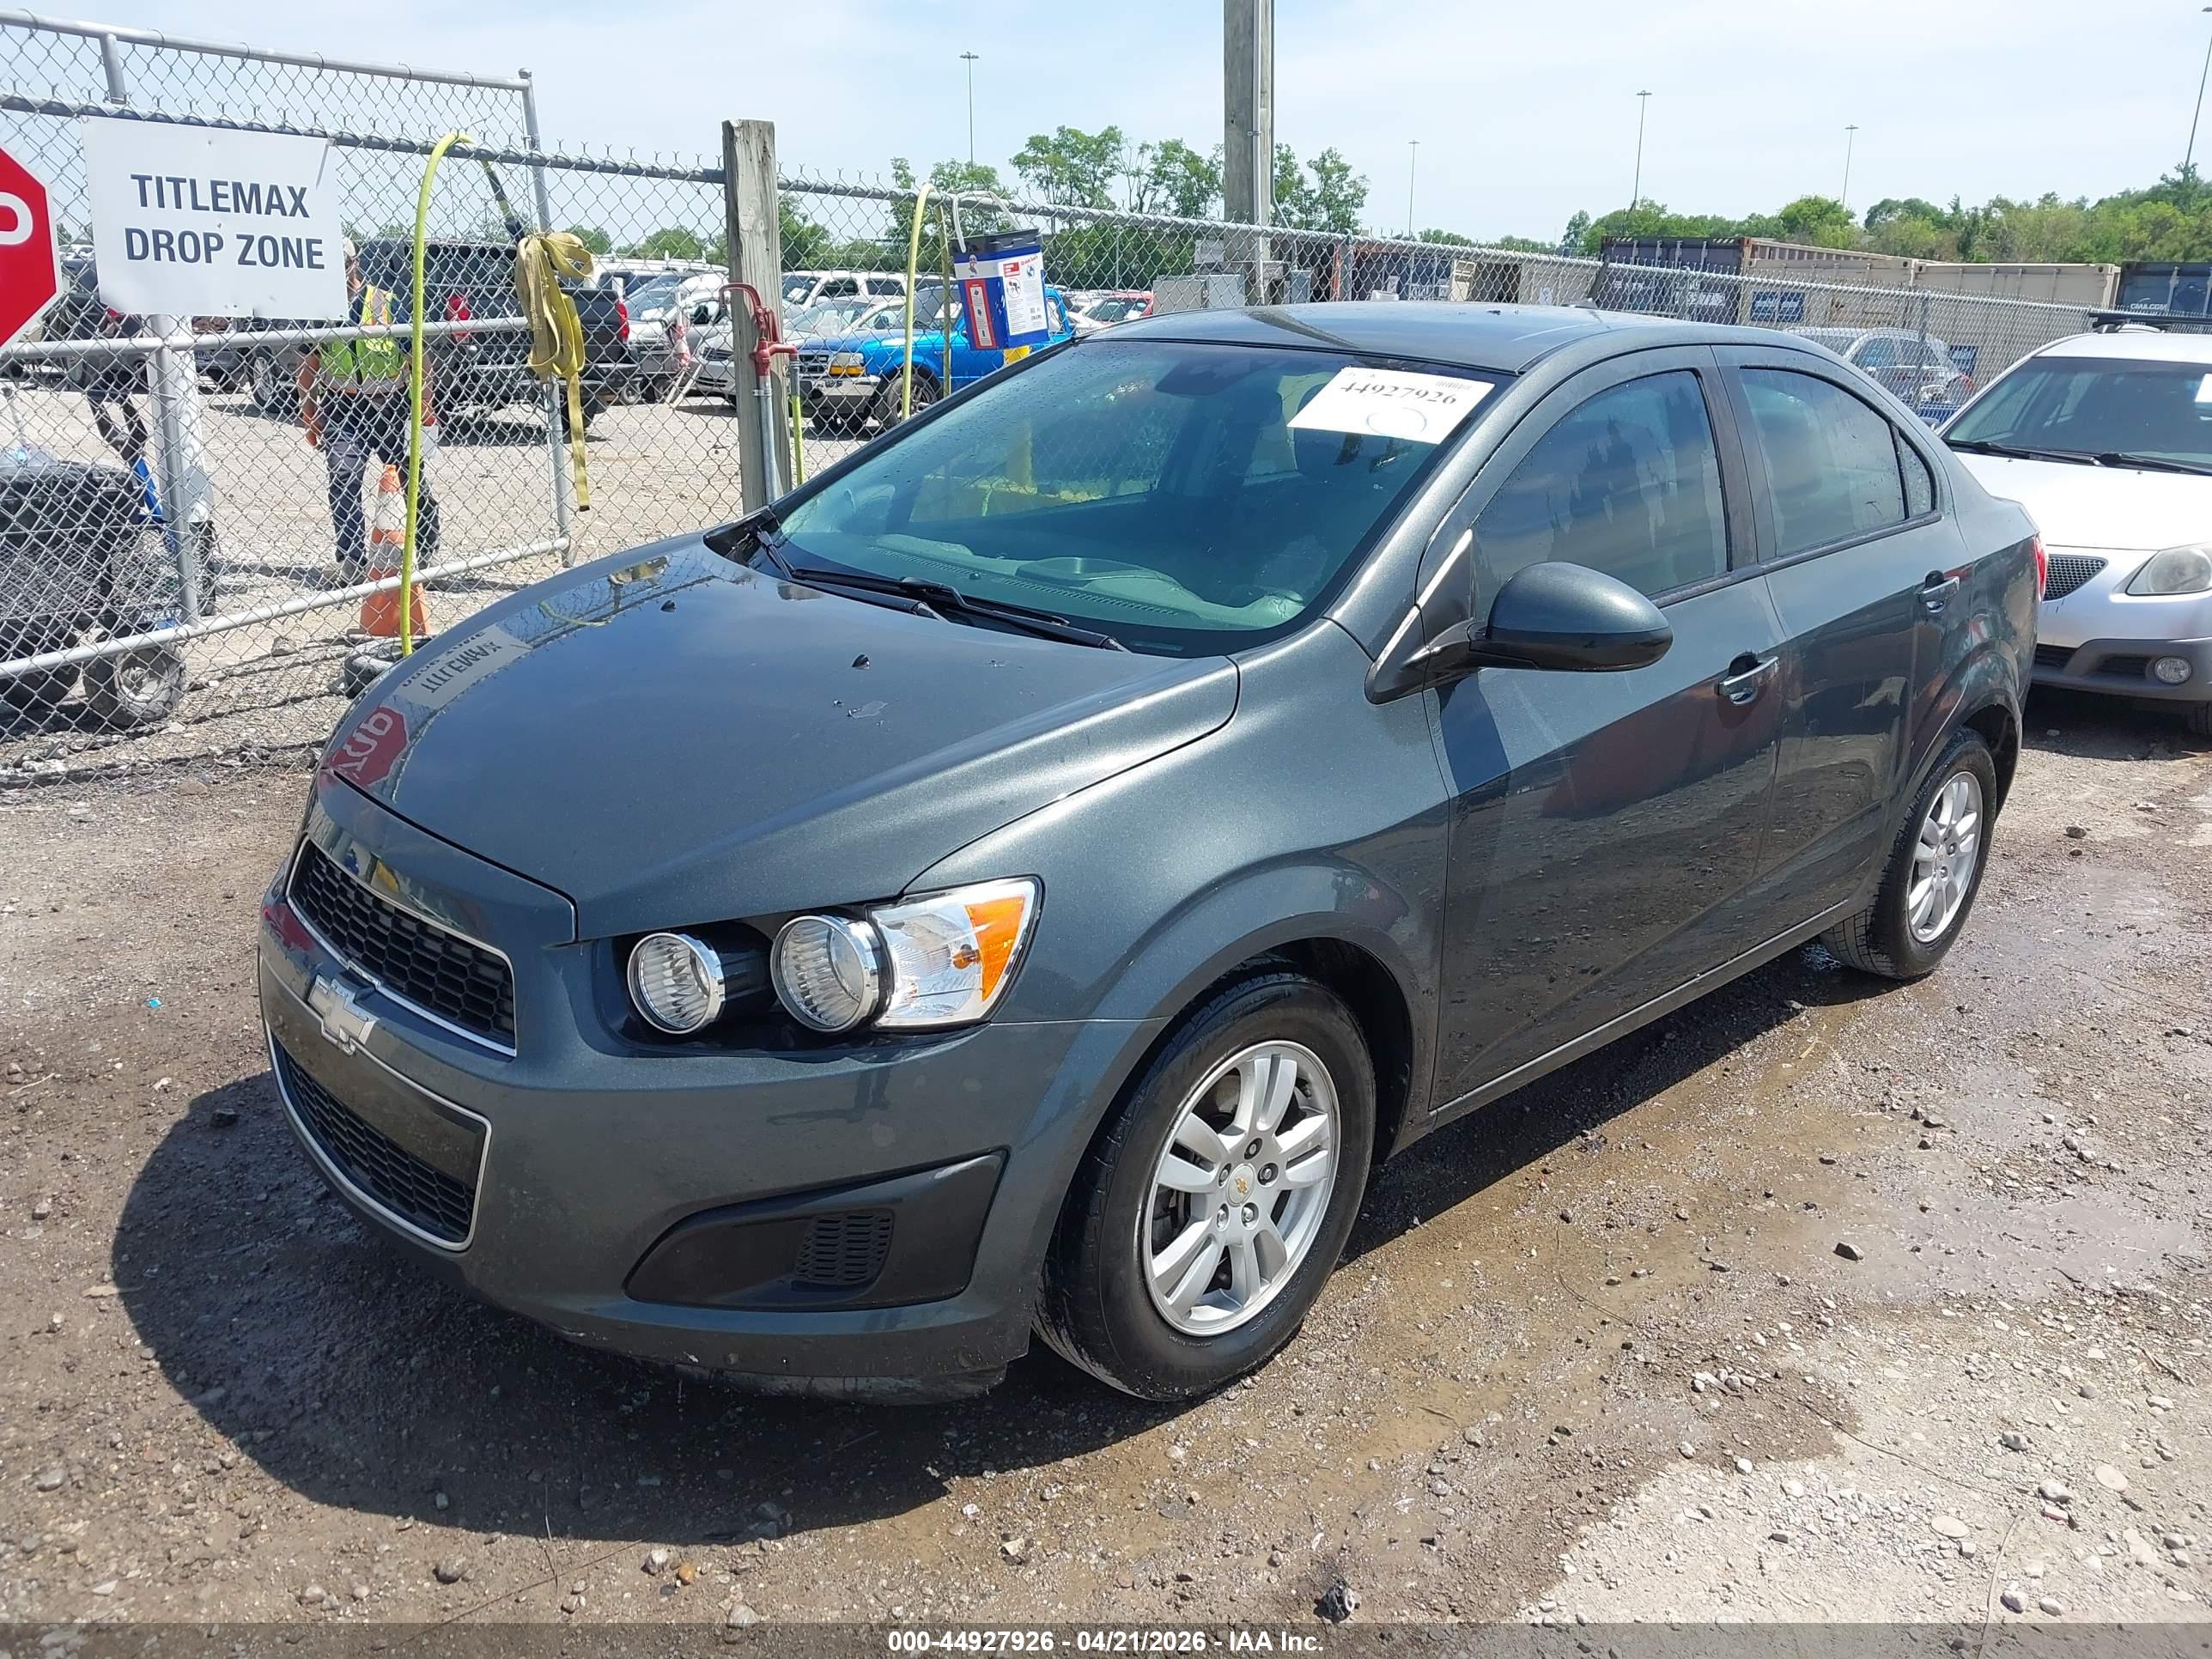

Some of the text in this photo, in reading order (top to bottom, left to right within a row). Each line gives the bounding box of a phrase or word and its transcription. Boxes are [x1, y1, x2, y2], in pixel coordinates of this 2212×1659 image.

[130, 173, 310, 218] TITLEMAX
[125, 228, 325, 270] DROP ZONE
[1340, 381, 1458, 404] 44927926
